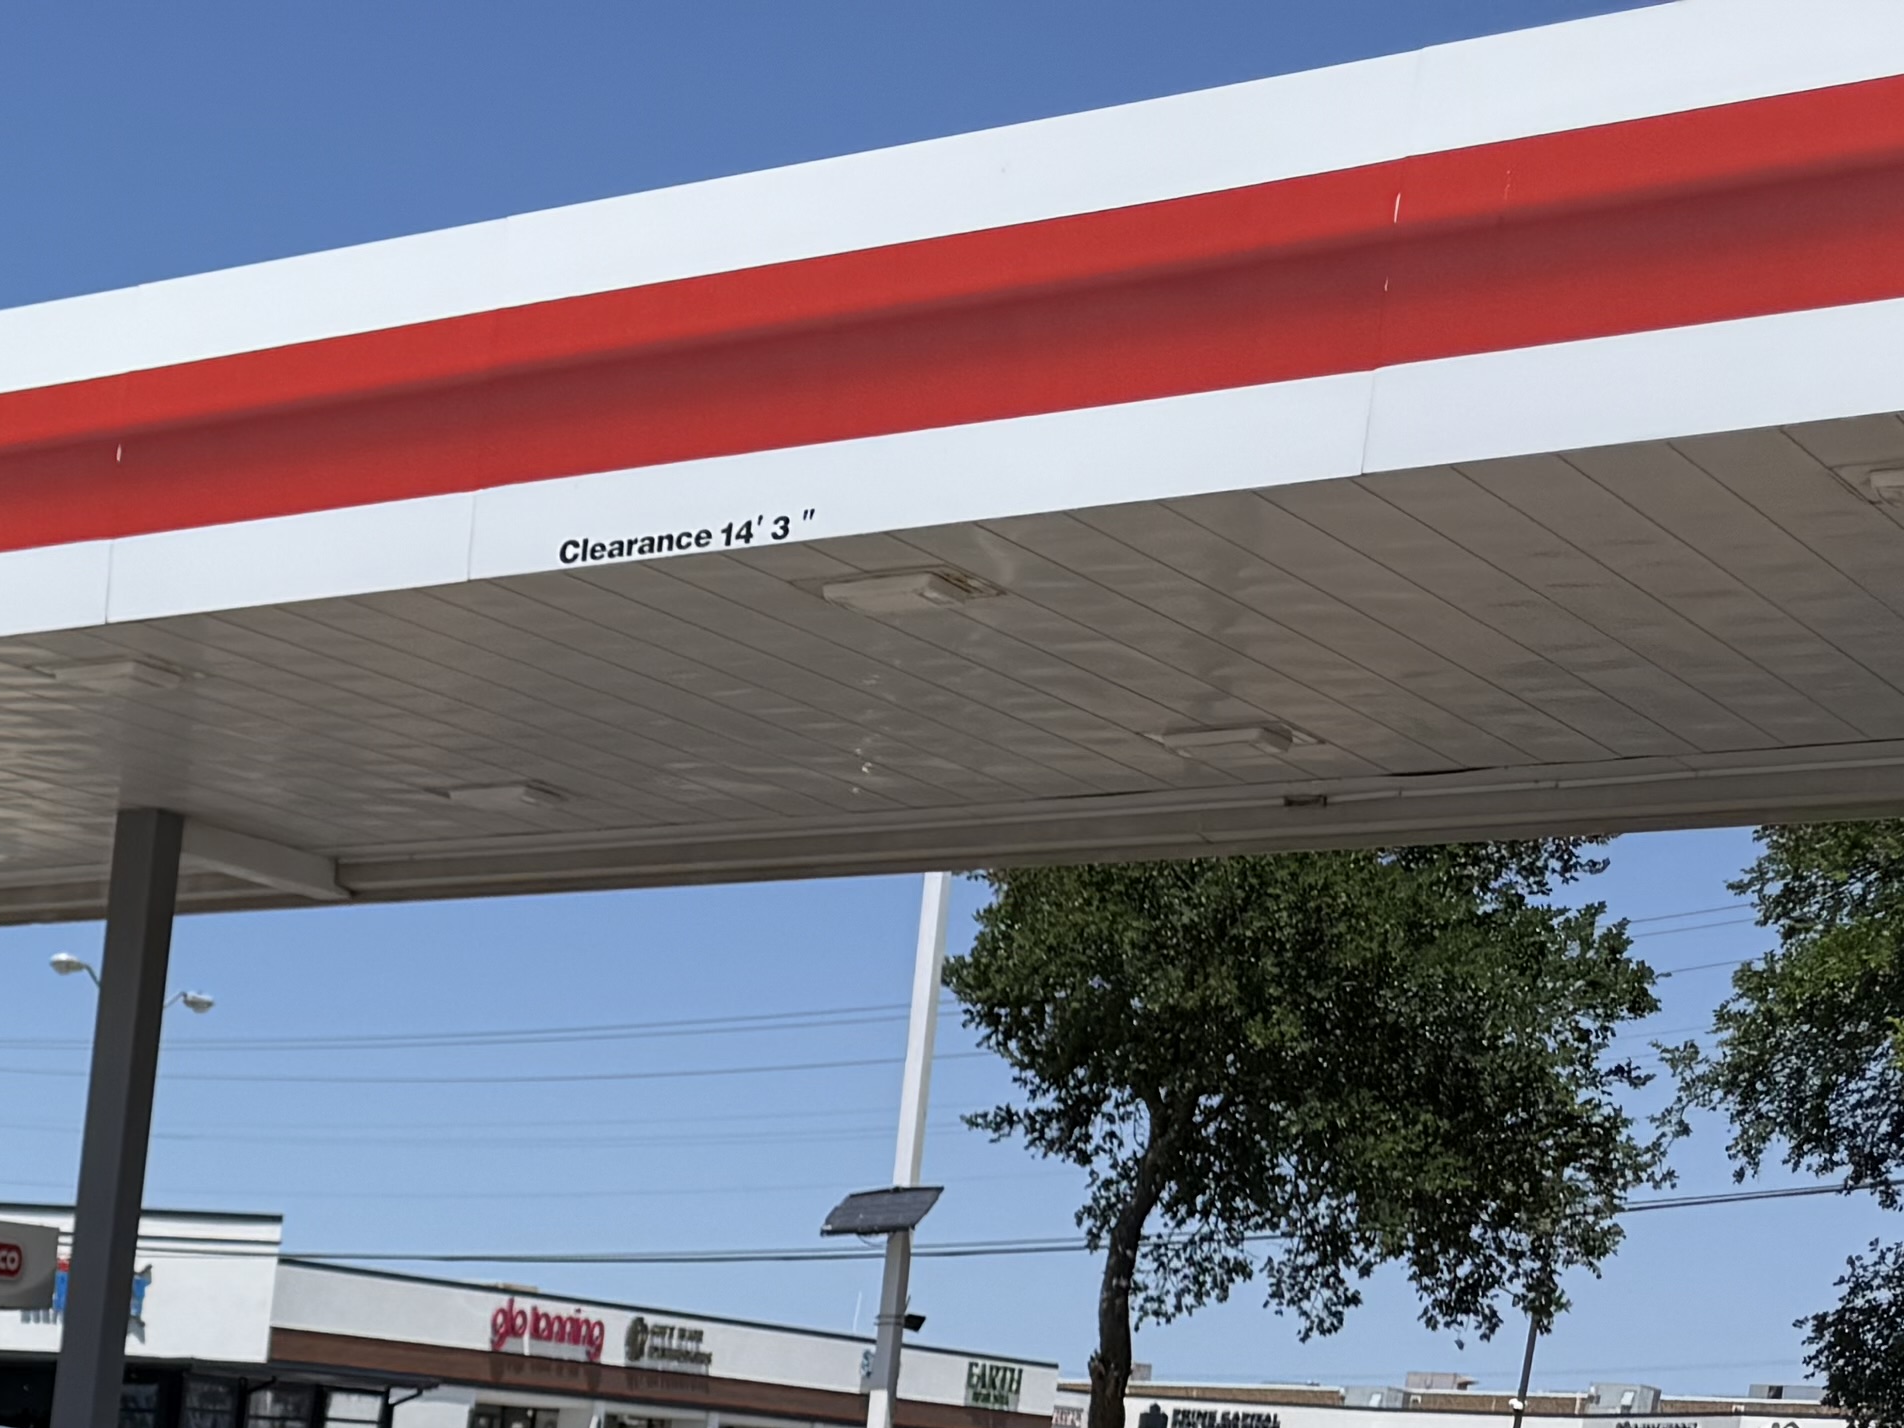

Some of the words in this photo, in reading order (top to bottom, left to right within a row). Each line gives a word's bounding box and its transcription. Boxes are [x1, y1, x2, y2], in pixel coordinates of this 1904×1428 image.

[559, 526, 712, 564] Clearance
[720, 514, 763, 547] 14'
[491, 1295, 528, 1352] glo
[529, 1305, 605, 1363] tanning
[967, 1361, 1023, 1395] EARTH
